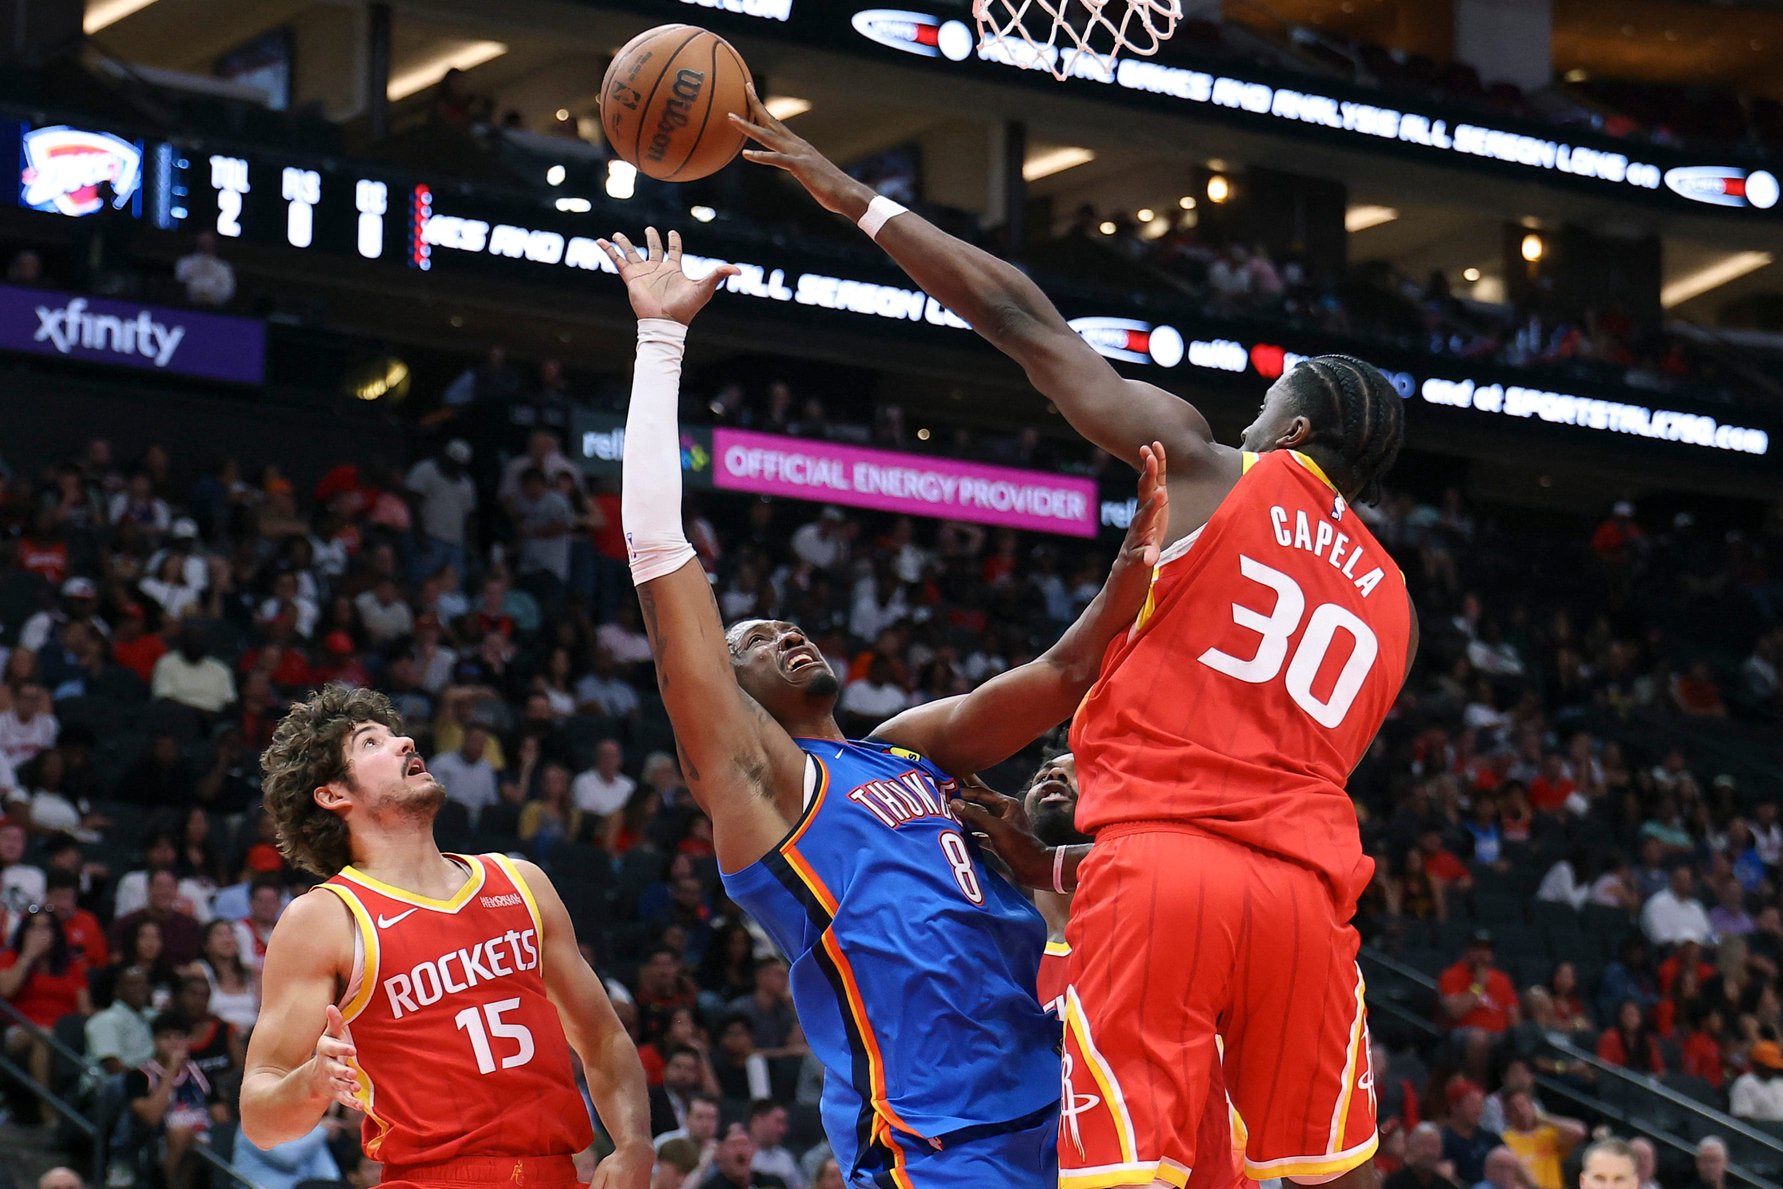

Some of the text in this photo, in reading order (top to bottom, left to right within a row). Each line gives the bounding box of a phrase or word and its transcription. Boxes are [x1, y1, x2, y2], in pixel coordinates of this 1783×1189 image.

[643, 68, 706, 163] Wilson
[1211, 77, 1273, 114] AND
[1271, 88, 1401, 139] ANALYSIS
[1398, 113, 1452, 149] ALL
[1452, 123, 1558, 169] SEASON
[1555, 143, 1629, 182] LONG
[216, 189, 243, 237] 2
[488, 224, 565, 264] AND
[34, 297, 187, 367] xfinity
[794, 273, 926, 322] SEASON
[724, 444, 1087, 522] OFFICIAL ENERGY PROVIDER
[1270, 505, 1386, 599] CAPELA
[1196, 553, 1379, 729] 30
[938, 829, 984, 907] 8
[383, 928, 538, 1020] ROCKETS
[453, 997, 536, 1075] 15
